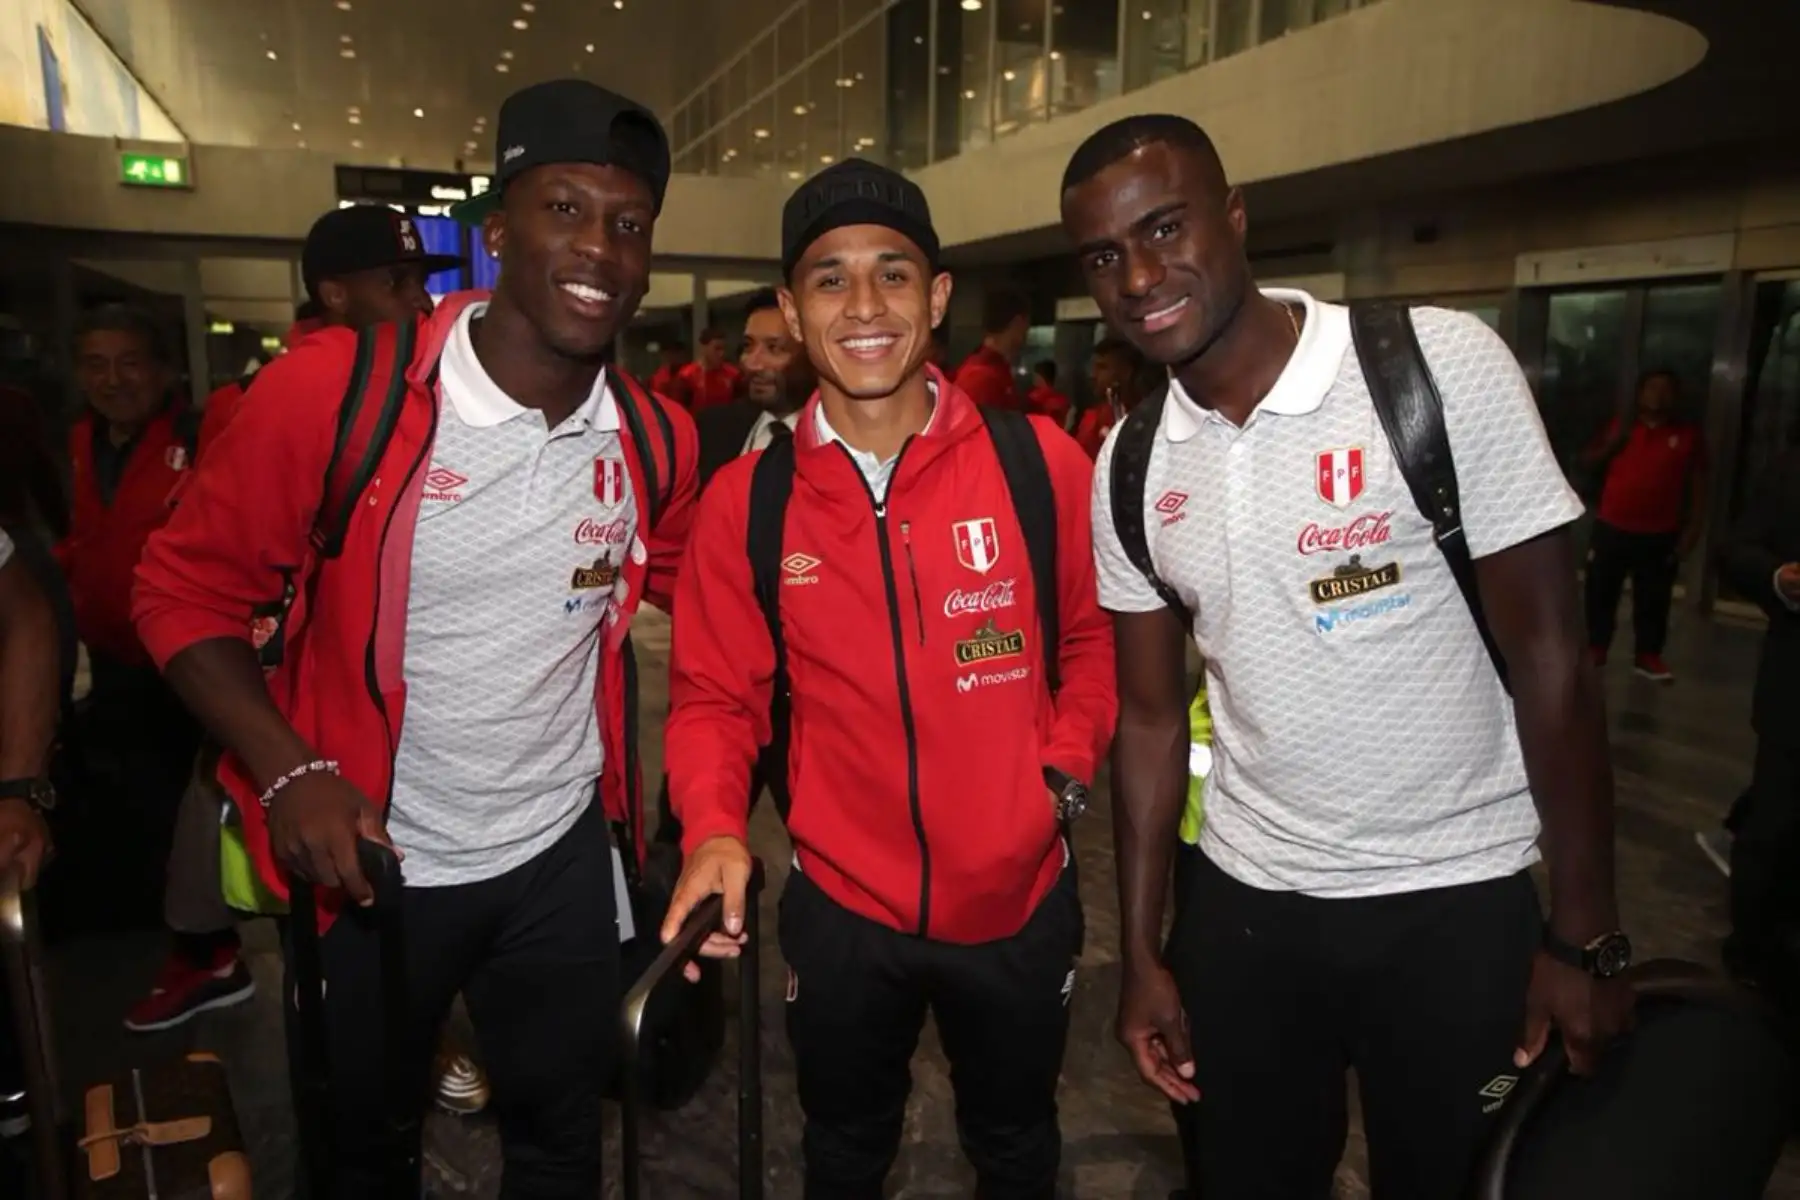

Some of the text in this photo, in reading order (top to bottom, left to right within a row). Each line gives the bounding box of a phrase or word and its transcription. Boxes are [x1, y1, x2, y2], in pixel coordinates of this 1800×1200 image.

[1297, 510, 1394, 555] Coca-Cola
[944, 577, 1016, 618] Coca-Cola
[1318, 571, 1391, 598] CRISTAL
[961, 635, 1019, 661] CRISTAL
